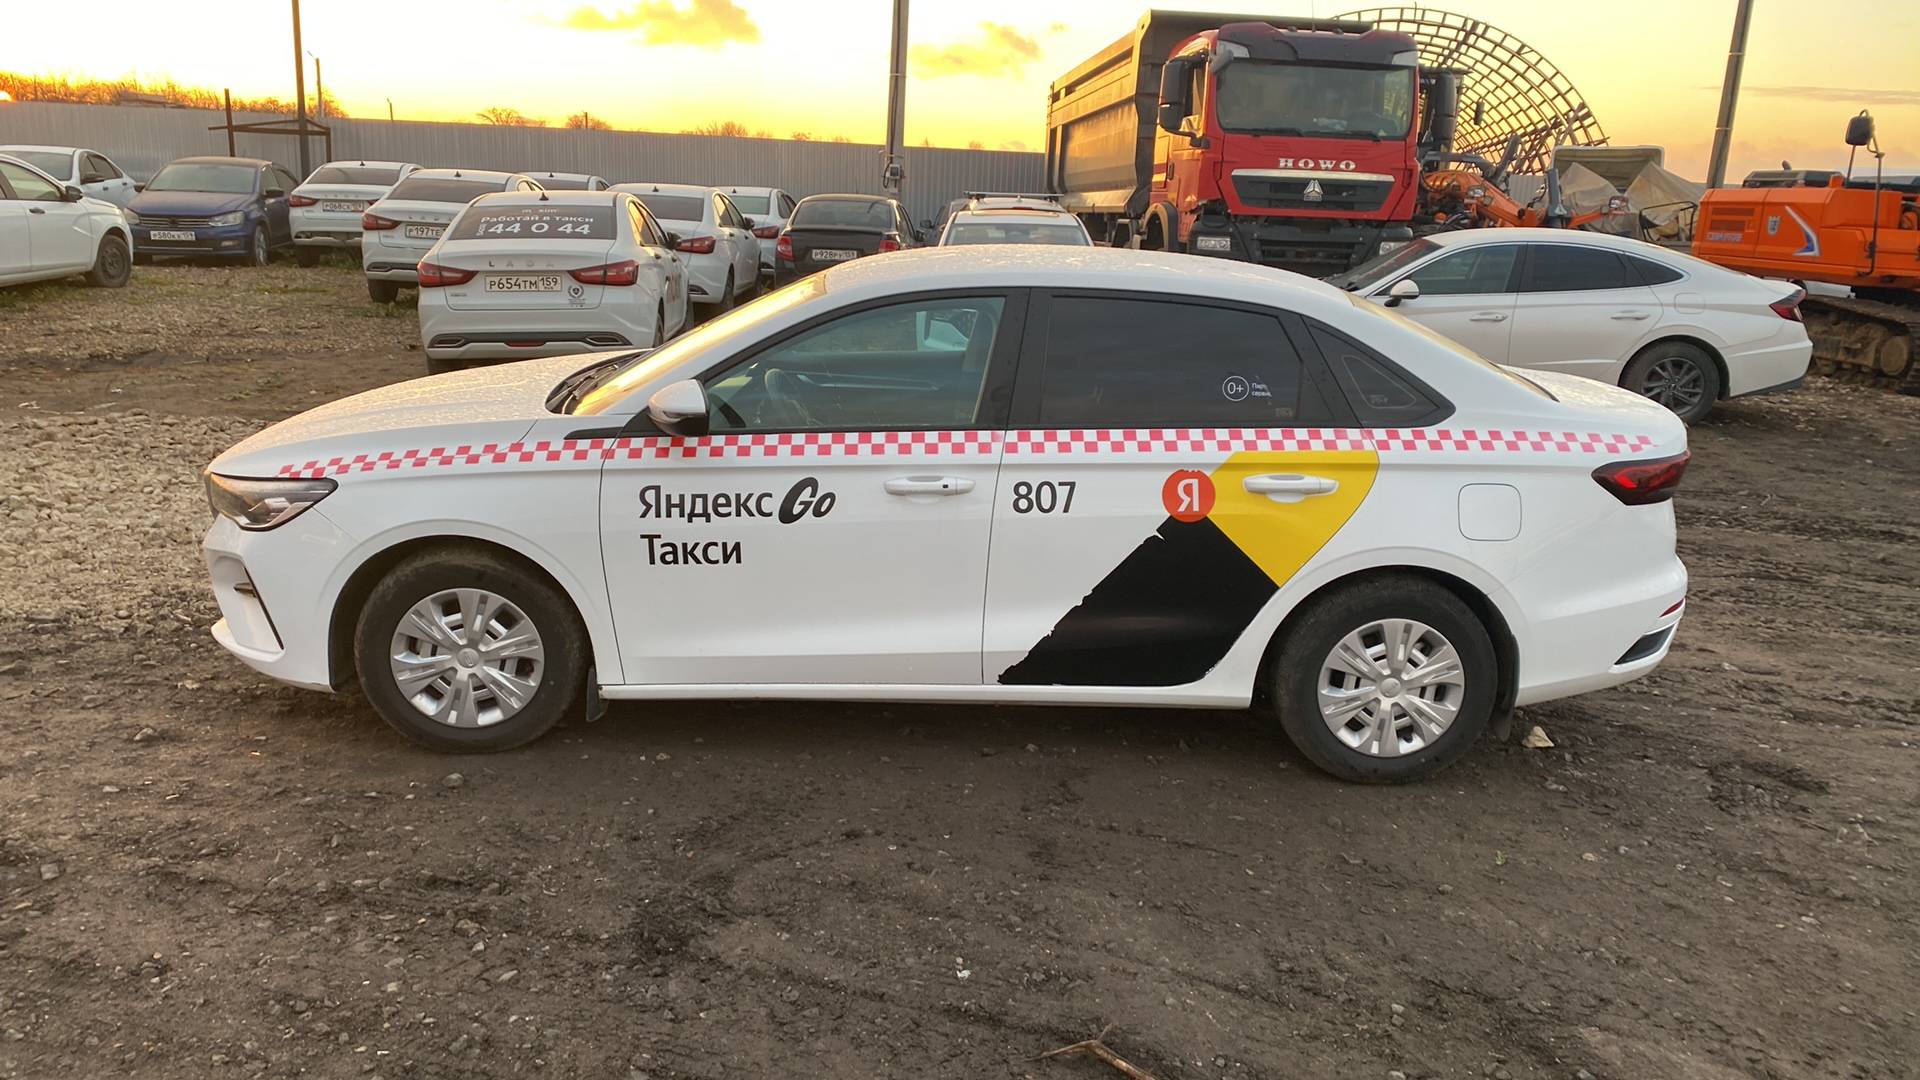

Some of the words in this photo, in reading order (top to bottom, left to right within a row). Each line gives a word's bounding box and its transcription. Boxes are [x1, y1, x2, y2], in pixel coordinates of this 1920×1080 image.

[1279, 157, 1356, 171] HOWO
[480, 215, 540, 223] Работай
[408, 227, 440, 236] Р197ТЕ
[488, 223, 521, 234] 44
[557, 223, 591, 235] 44
[488, 260, 555, 268] LADA
[489, 278, 538, 290] Р654ТМ
[540, 277, 558, 287] 159
[1227, 382, 1244, 394] 0+
[638, 485, 773, 523] Яндекс
[778, 477, 837, 524] Go
[1012, 481, 1077, 514] 807
[1177, 478, 1199, 512] Я
[640, 534, 743, 565] Такси
